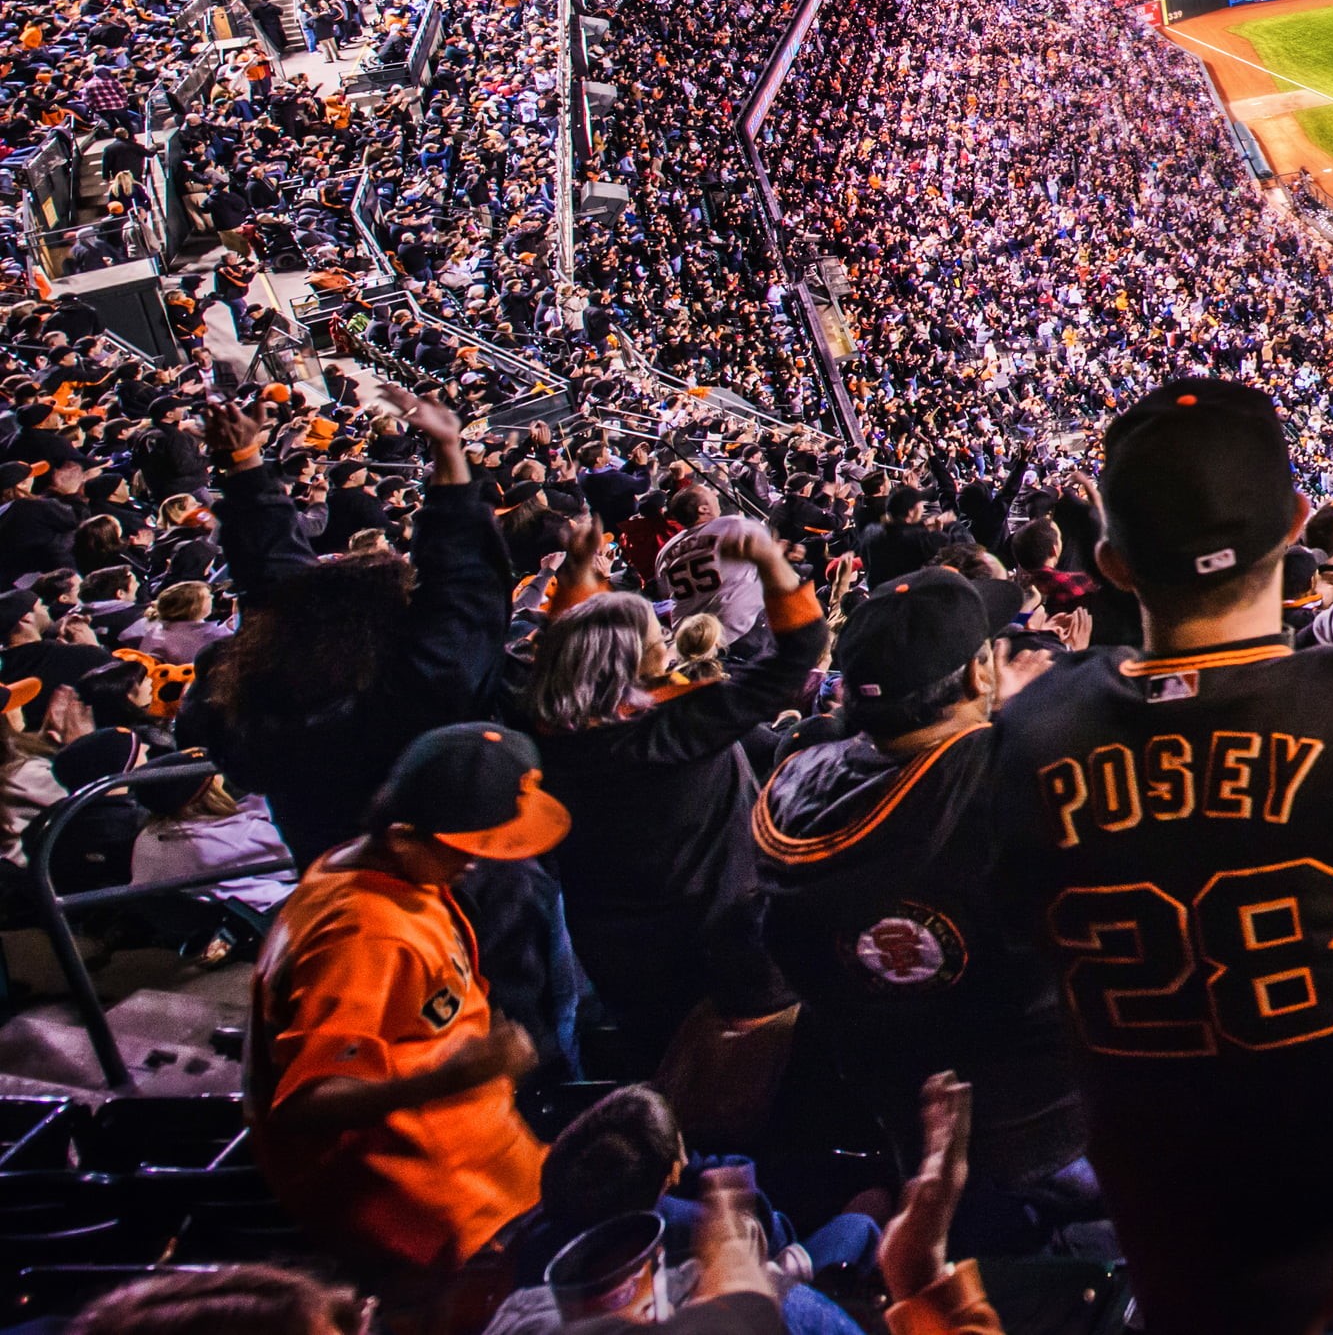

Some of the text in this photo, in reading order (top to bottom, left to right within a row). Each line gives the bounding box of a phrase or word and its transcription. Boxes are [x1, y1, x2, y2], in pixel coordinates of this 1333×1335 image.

[1168, 10, 1182, 21] 339
[668, 554, 722, 600] 55
[1038, 731, 1324, 849] POSEY
